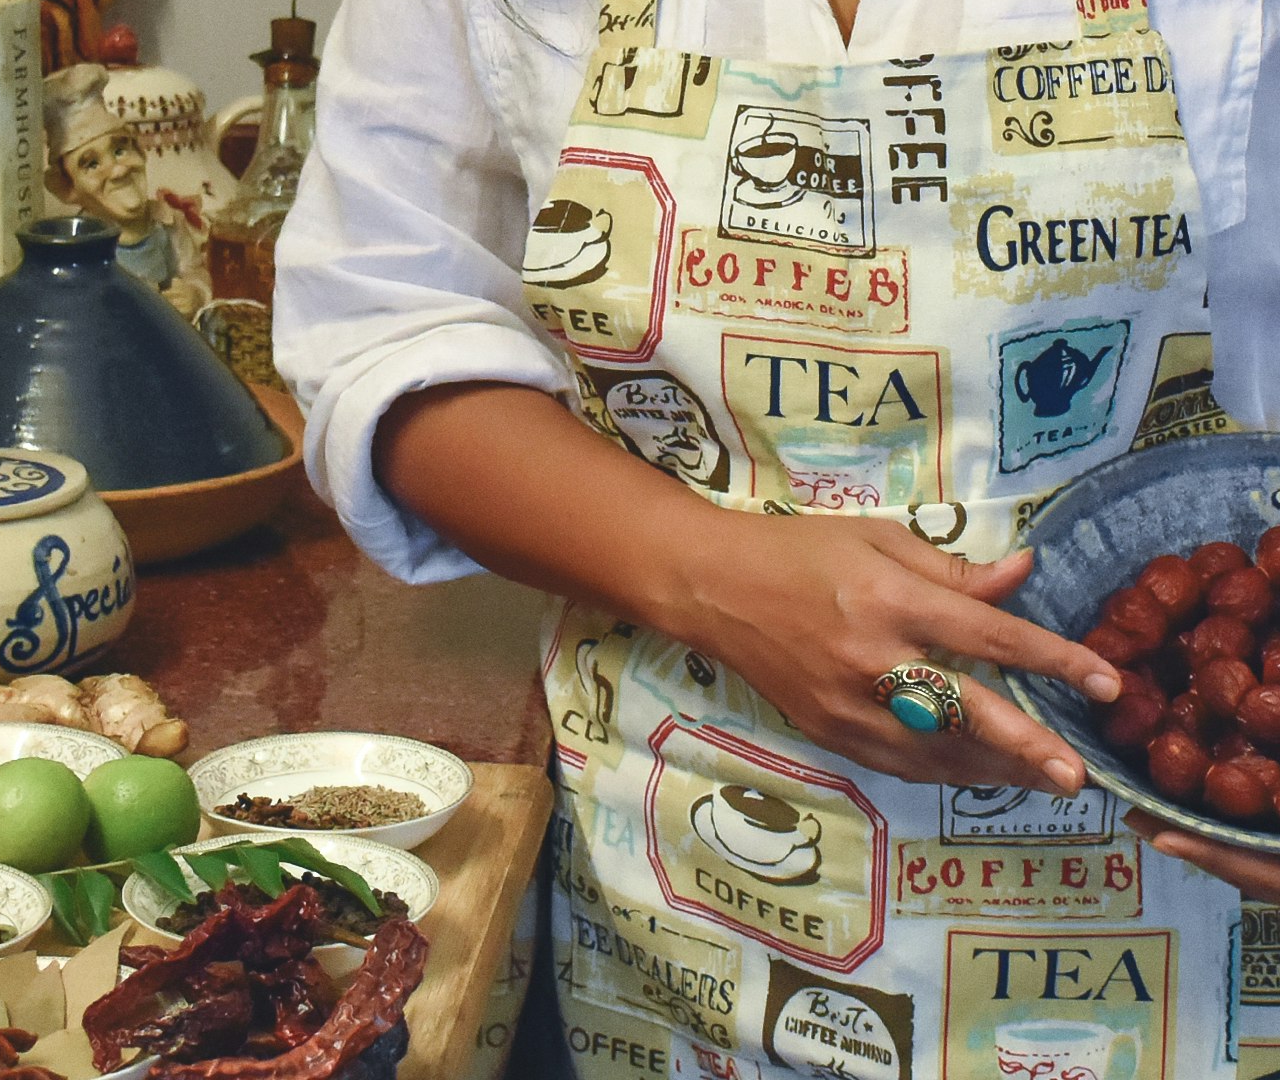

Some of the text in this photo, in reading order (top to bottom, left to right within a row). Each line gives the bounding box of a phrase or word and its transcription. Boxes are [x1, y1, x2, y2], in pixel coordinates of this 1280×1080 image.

[993, 56, 1175, 103] COFFEE D
[13, 27, 32, 219] FARMHOUSE
[746, 215, 849, 244] DELICIOUS
[1129, 213, 1193, 259] TEA
[744, 352, 928, 427] TEA
[1033, 426, 1074, 445] TEA
[970, 821, 1087, 834] DELICIOUS
[695, 867, 825, 941] COFFEE
[972, 947, 1155, 1002] TEA
[568, 1026, 666, 1075] OFFEE
